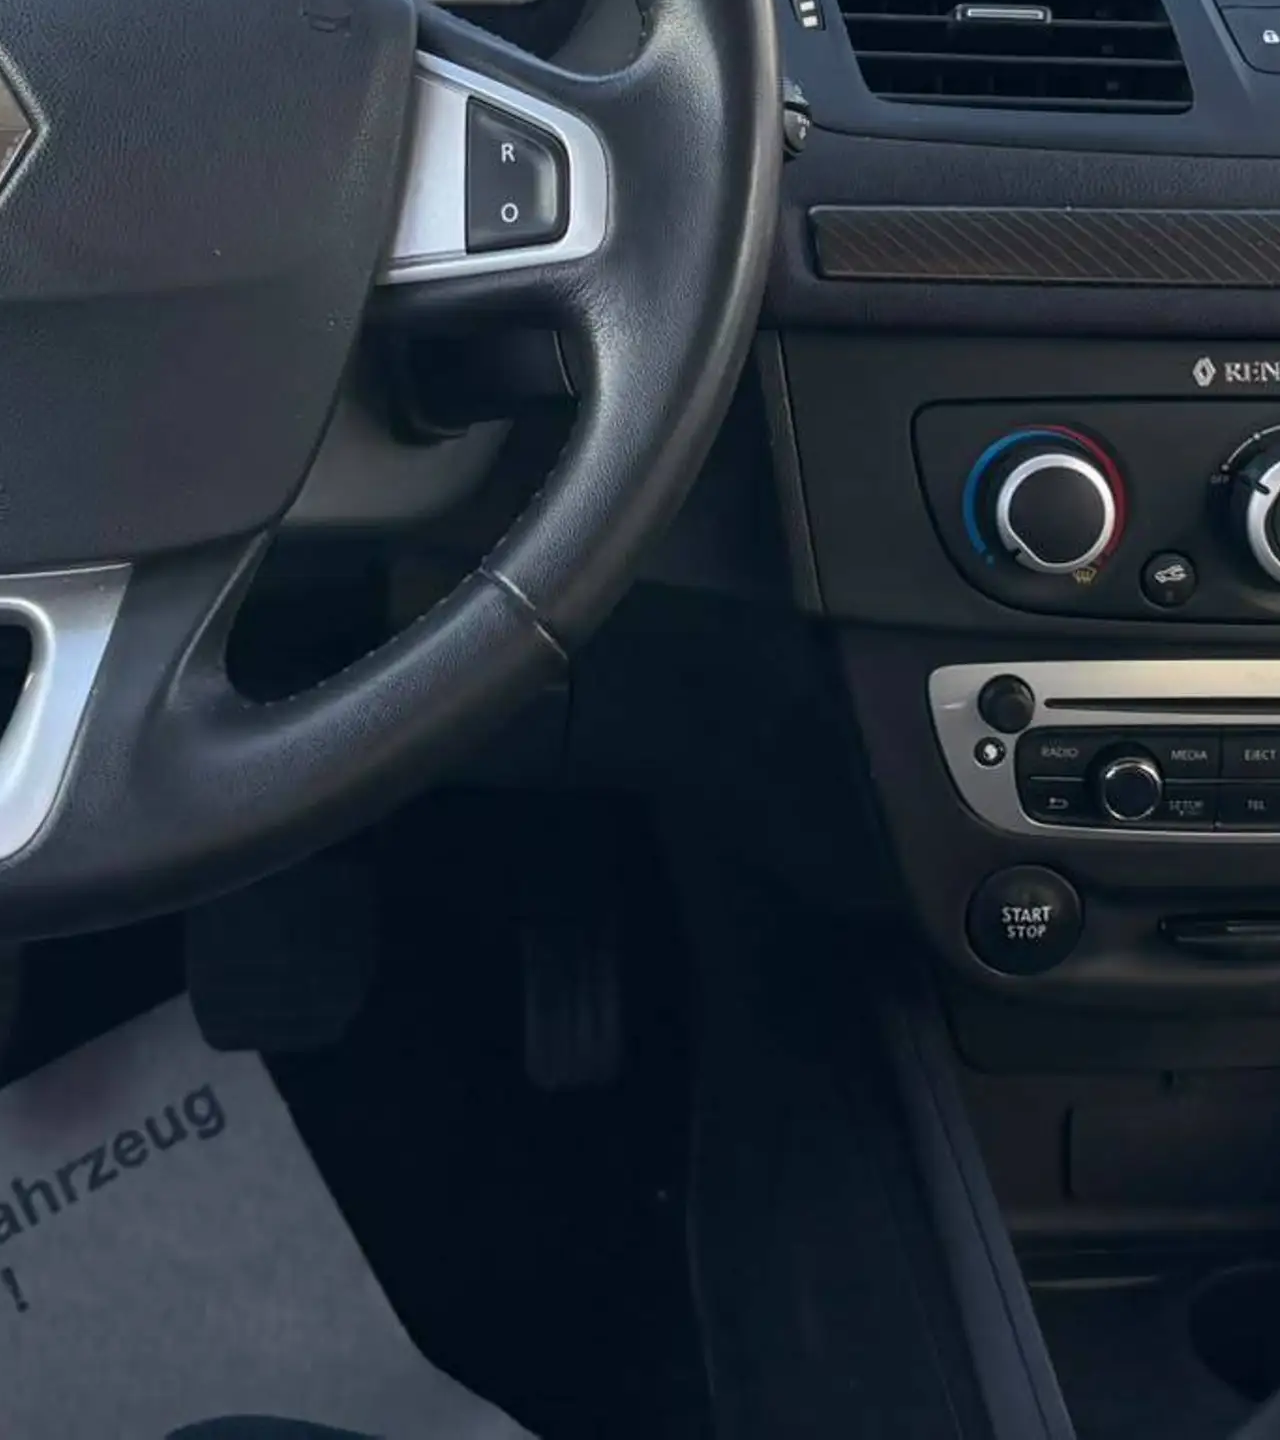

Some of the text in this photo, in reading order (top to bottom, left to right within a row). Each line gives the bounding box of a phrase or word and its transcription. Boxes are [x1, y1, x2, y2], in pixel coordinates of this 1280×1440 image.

[500, 142, 516, 163] R
[1041, 746, 1080, 758] RADIO
[1171, 749, 1208, 761] MEDIA
[1244, 749, 1276, 761] EJECT
[1001, 906, 1052, 922] START
[1007, 923, 1047, 939] STOP
[1, 1266, 29, 1313] !
